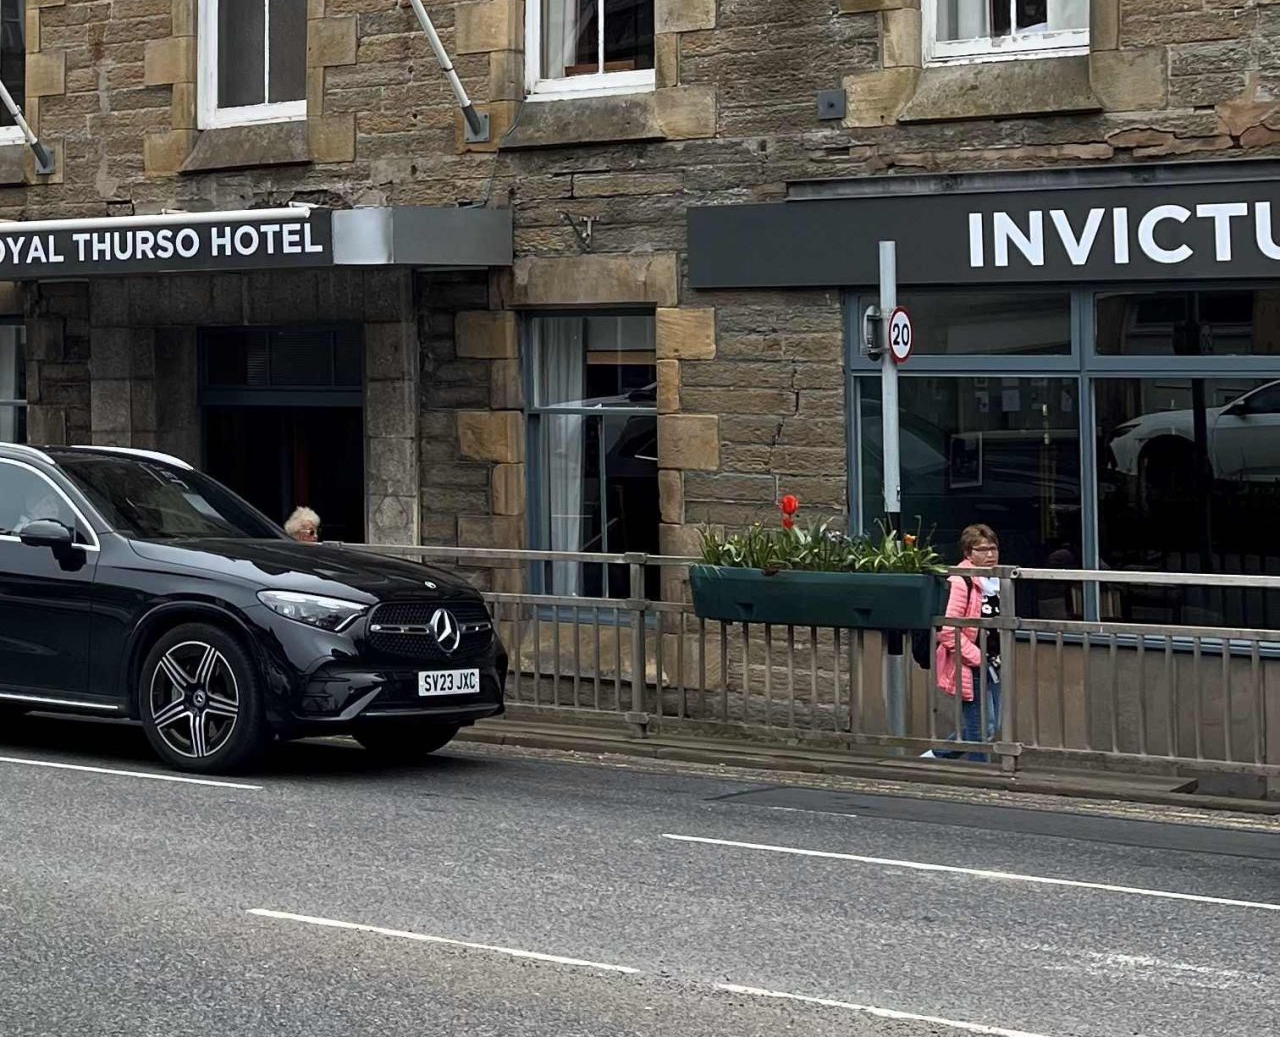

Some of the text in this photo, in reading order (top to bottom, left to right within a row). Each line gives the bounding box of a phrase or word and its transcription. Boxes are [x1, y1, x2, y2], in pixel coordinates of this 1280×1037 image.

[72, 229, 200, 261] THURSO
[211, 223, 323, 256] HOTEL
[892, 323, 910, 346] 20
[424, 672, 475, 692] SV23 JXC
